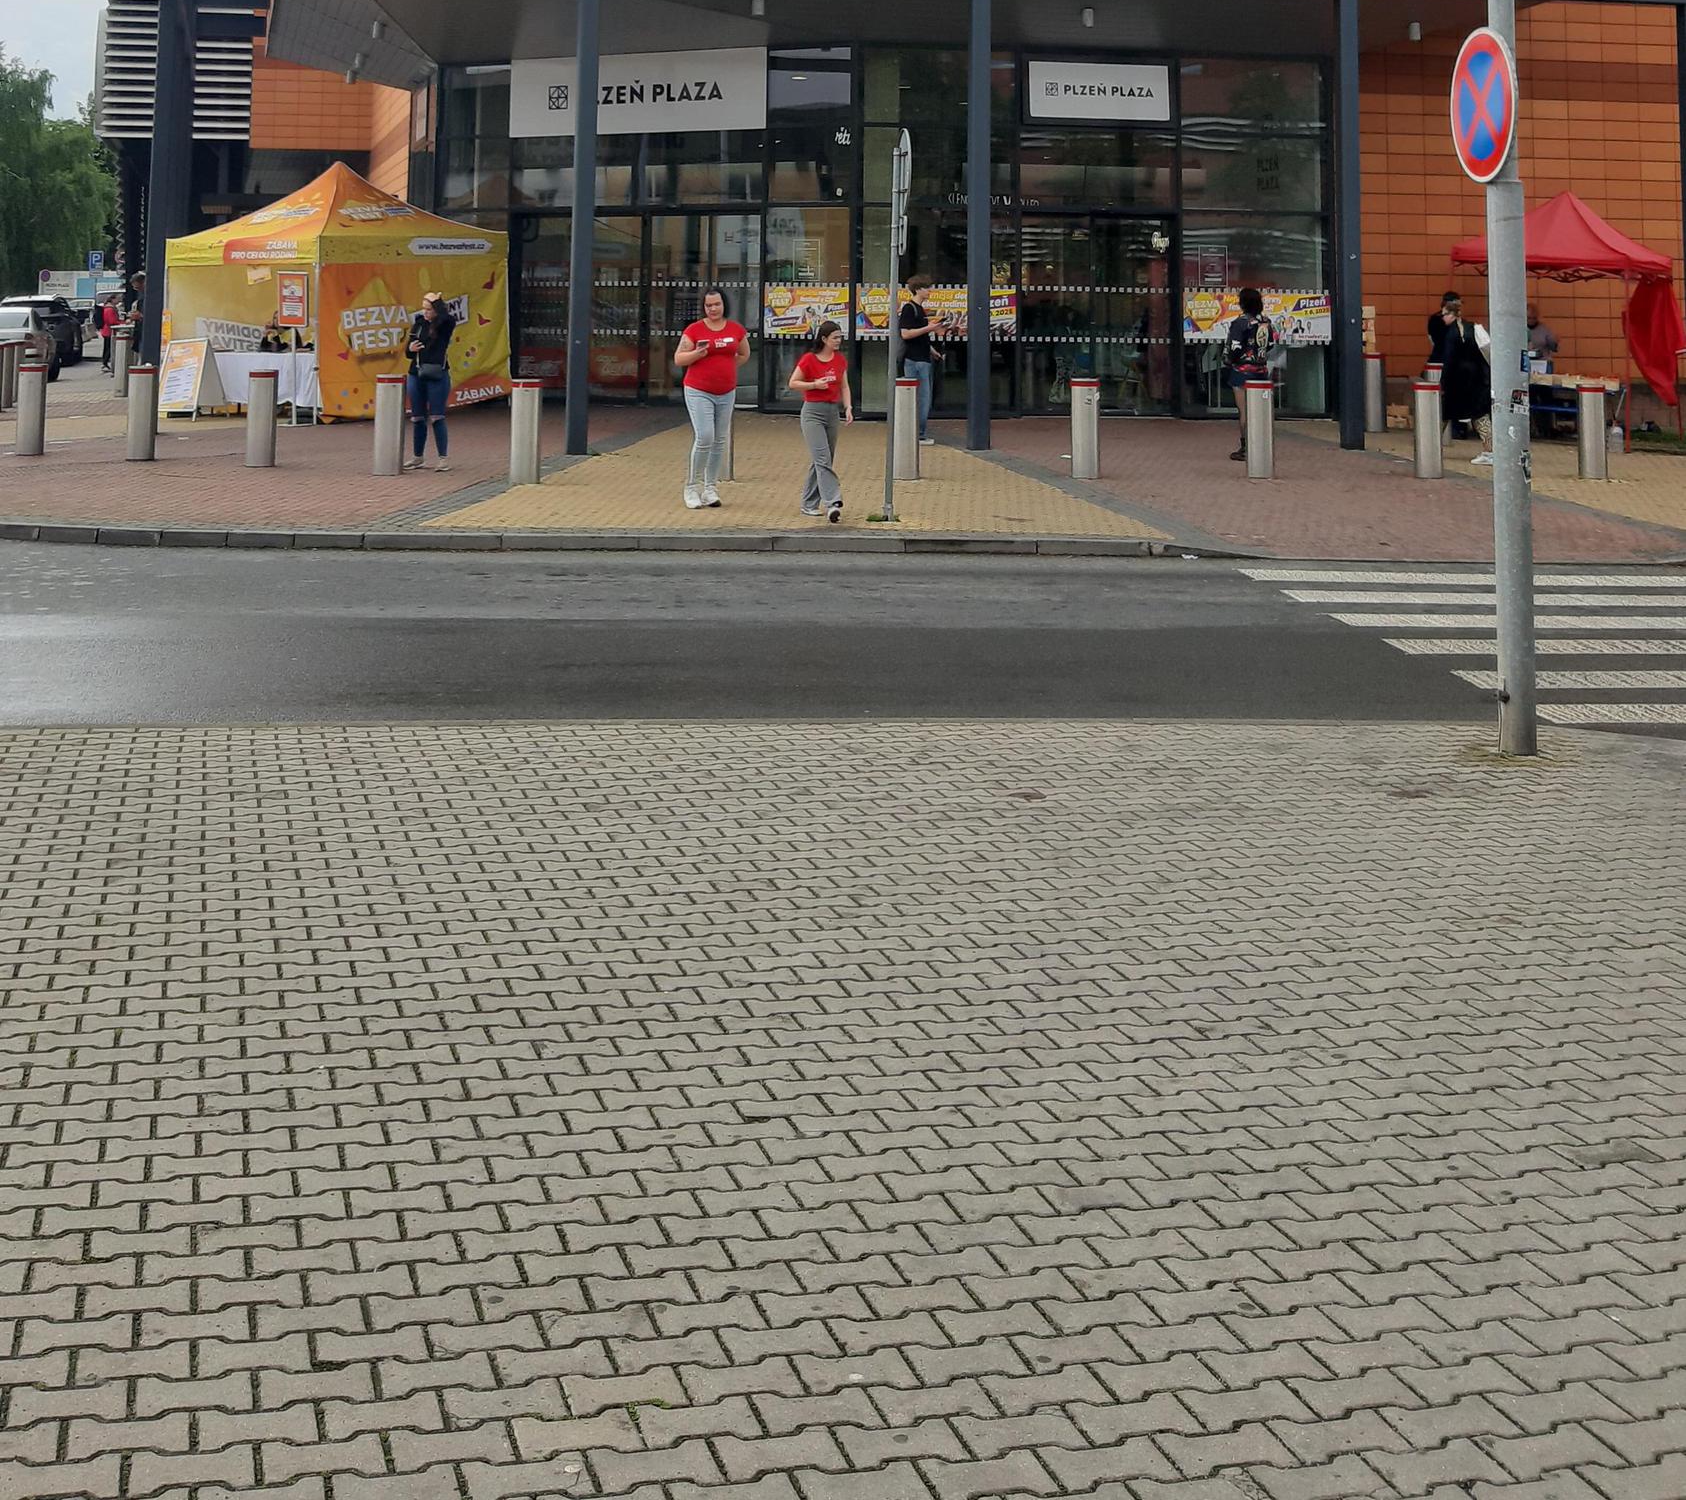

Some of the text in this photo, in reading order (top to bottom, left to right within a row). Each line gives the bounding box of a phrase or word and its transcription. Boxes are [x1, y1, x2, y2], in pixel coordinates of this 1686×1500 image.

[596, 80, 723, 105] ZEŇ PLAZA
[1063, 83, 1154, 98] PLZEŇ PLAZA
[92, 253, 101, 265] P
[990, 295, 1009, 307] zeň
[1300, 296, 1326, 308] Plzeň
[342, 305, 408, 329] BEZVA
[351, 327, 403, 351] FEST
